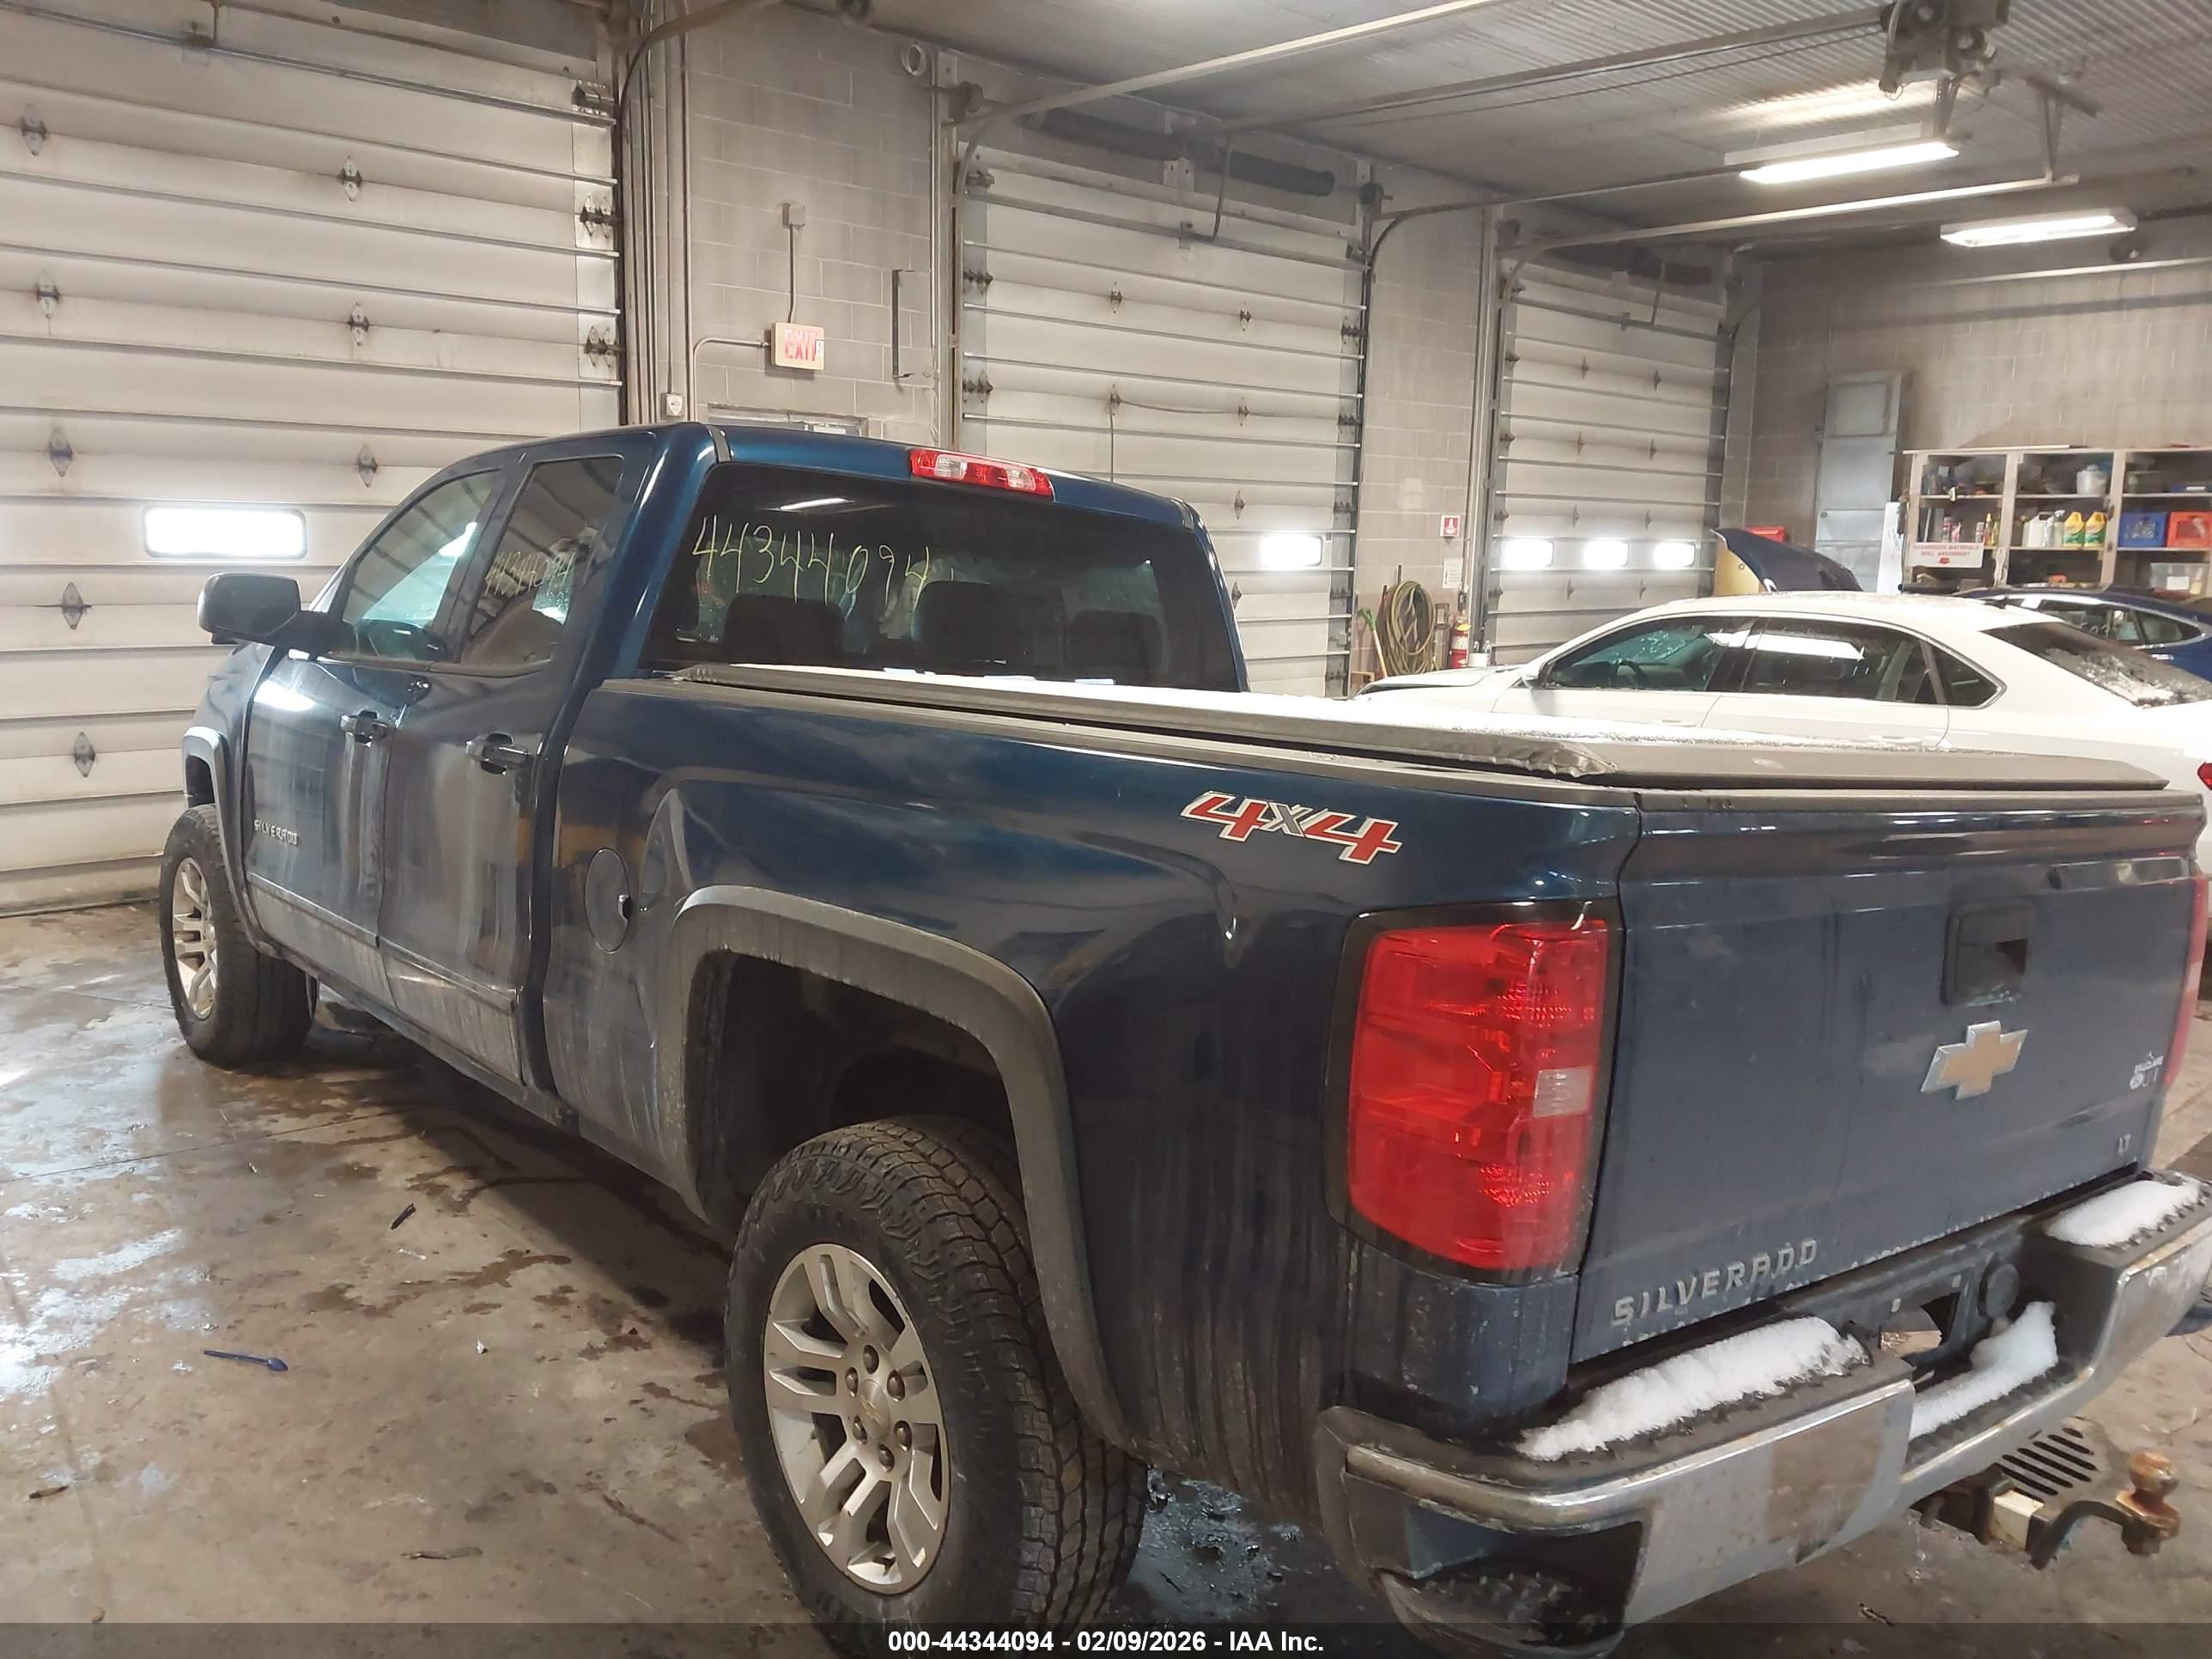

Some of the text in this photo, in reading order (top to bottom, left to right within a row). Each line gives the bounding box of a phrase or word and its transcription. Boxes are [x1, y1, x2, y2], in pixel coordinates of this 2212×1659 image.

[783, 329, 818, 362] EXIT
[691, 514, 931, 605] 44344094
[253, 818, 299, 846] SILVERADO
[1610, 1237, 1819, 1327] SILVERADO
